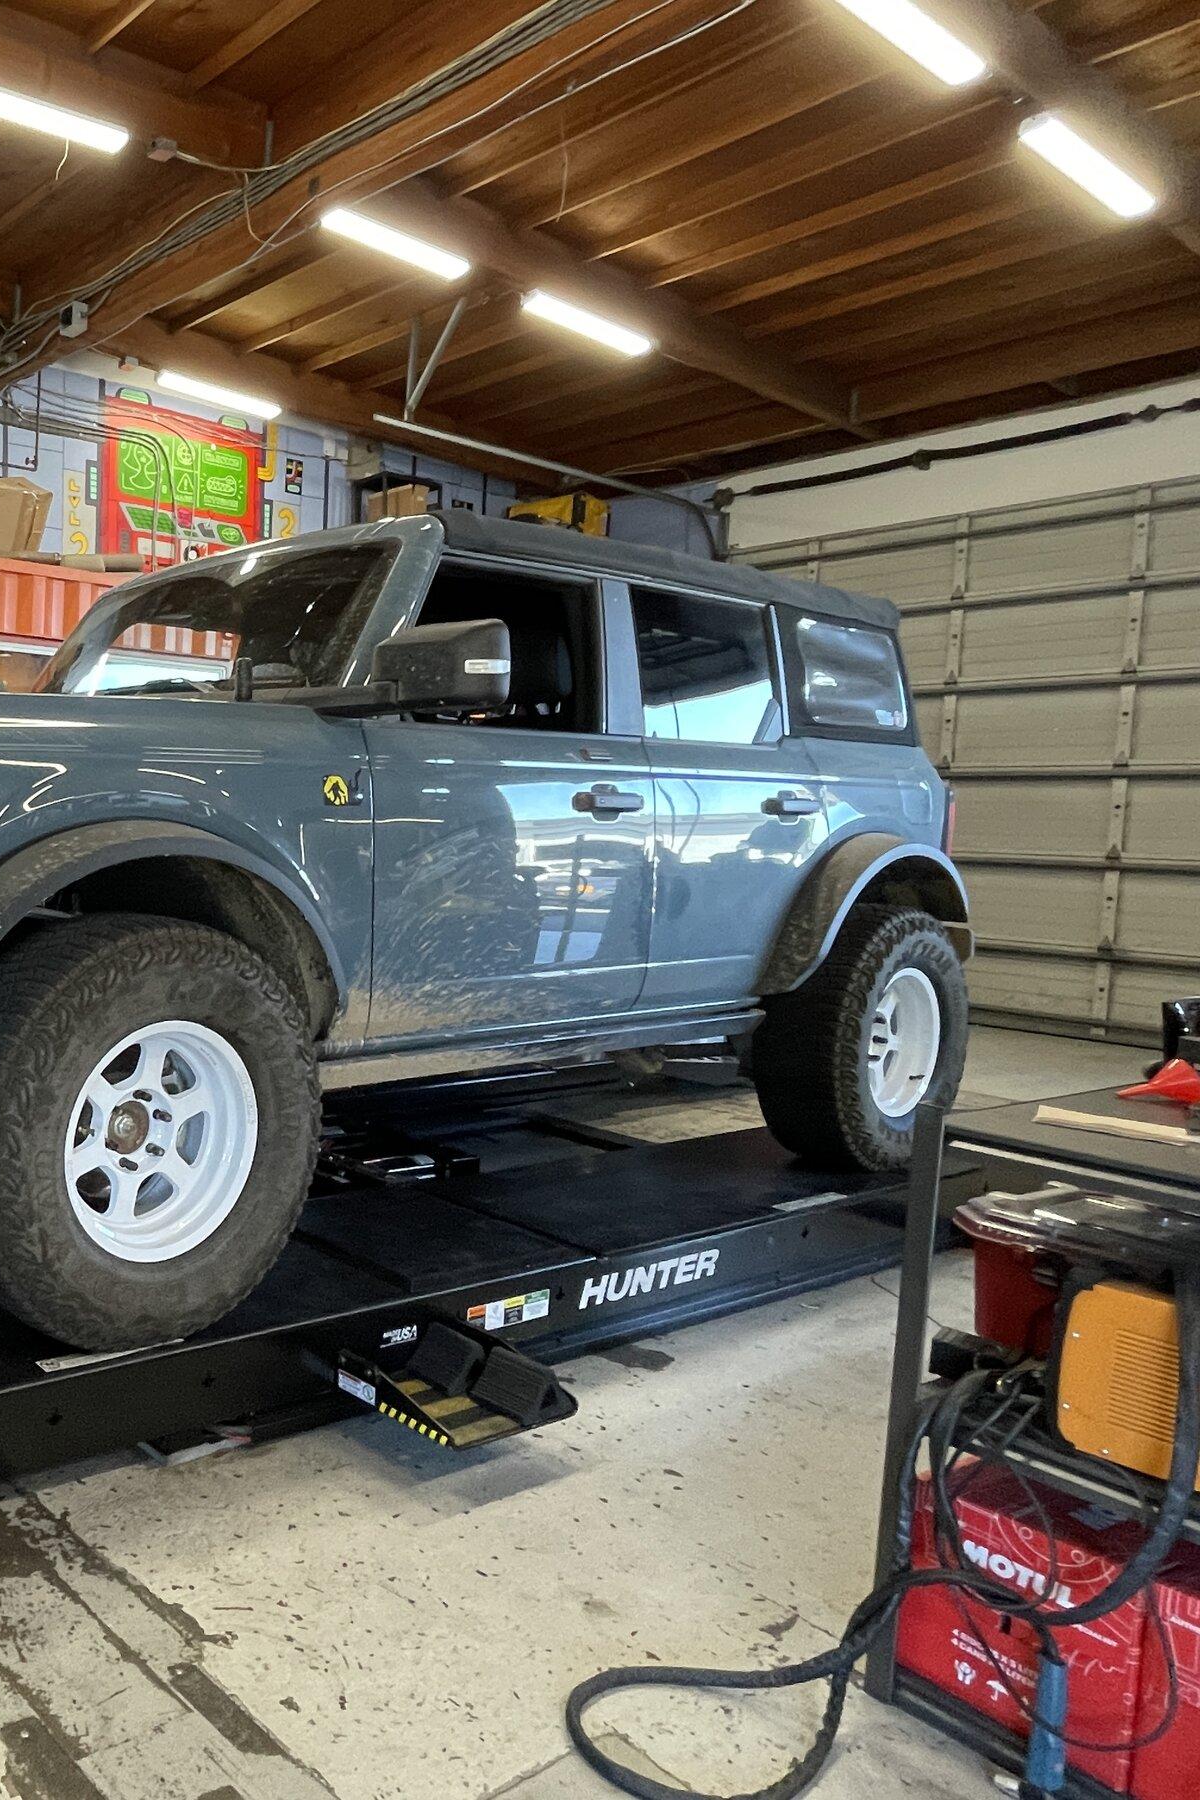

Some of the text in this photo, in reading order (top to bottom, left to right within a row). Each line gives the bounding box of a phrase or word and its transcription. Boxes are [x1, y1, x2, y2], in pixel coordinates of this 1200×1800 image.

[279, 508, 296, 538] 2
[578, 1249, 719, 1310] HUNTER
[397, 1324, 418, 1341] USA
[963, 1540, 1076, 1609] MOTUL
